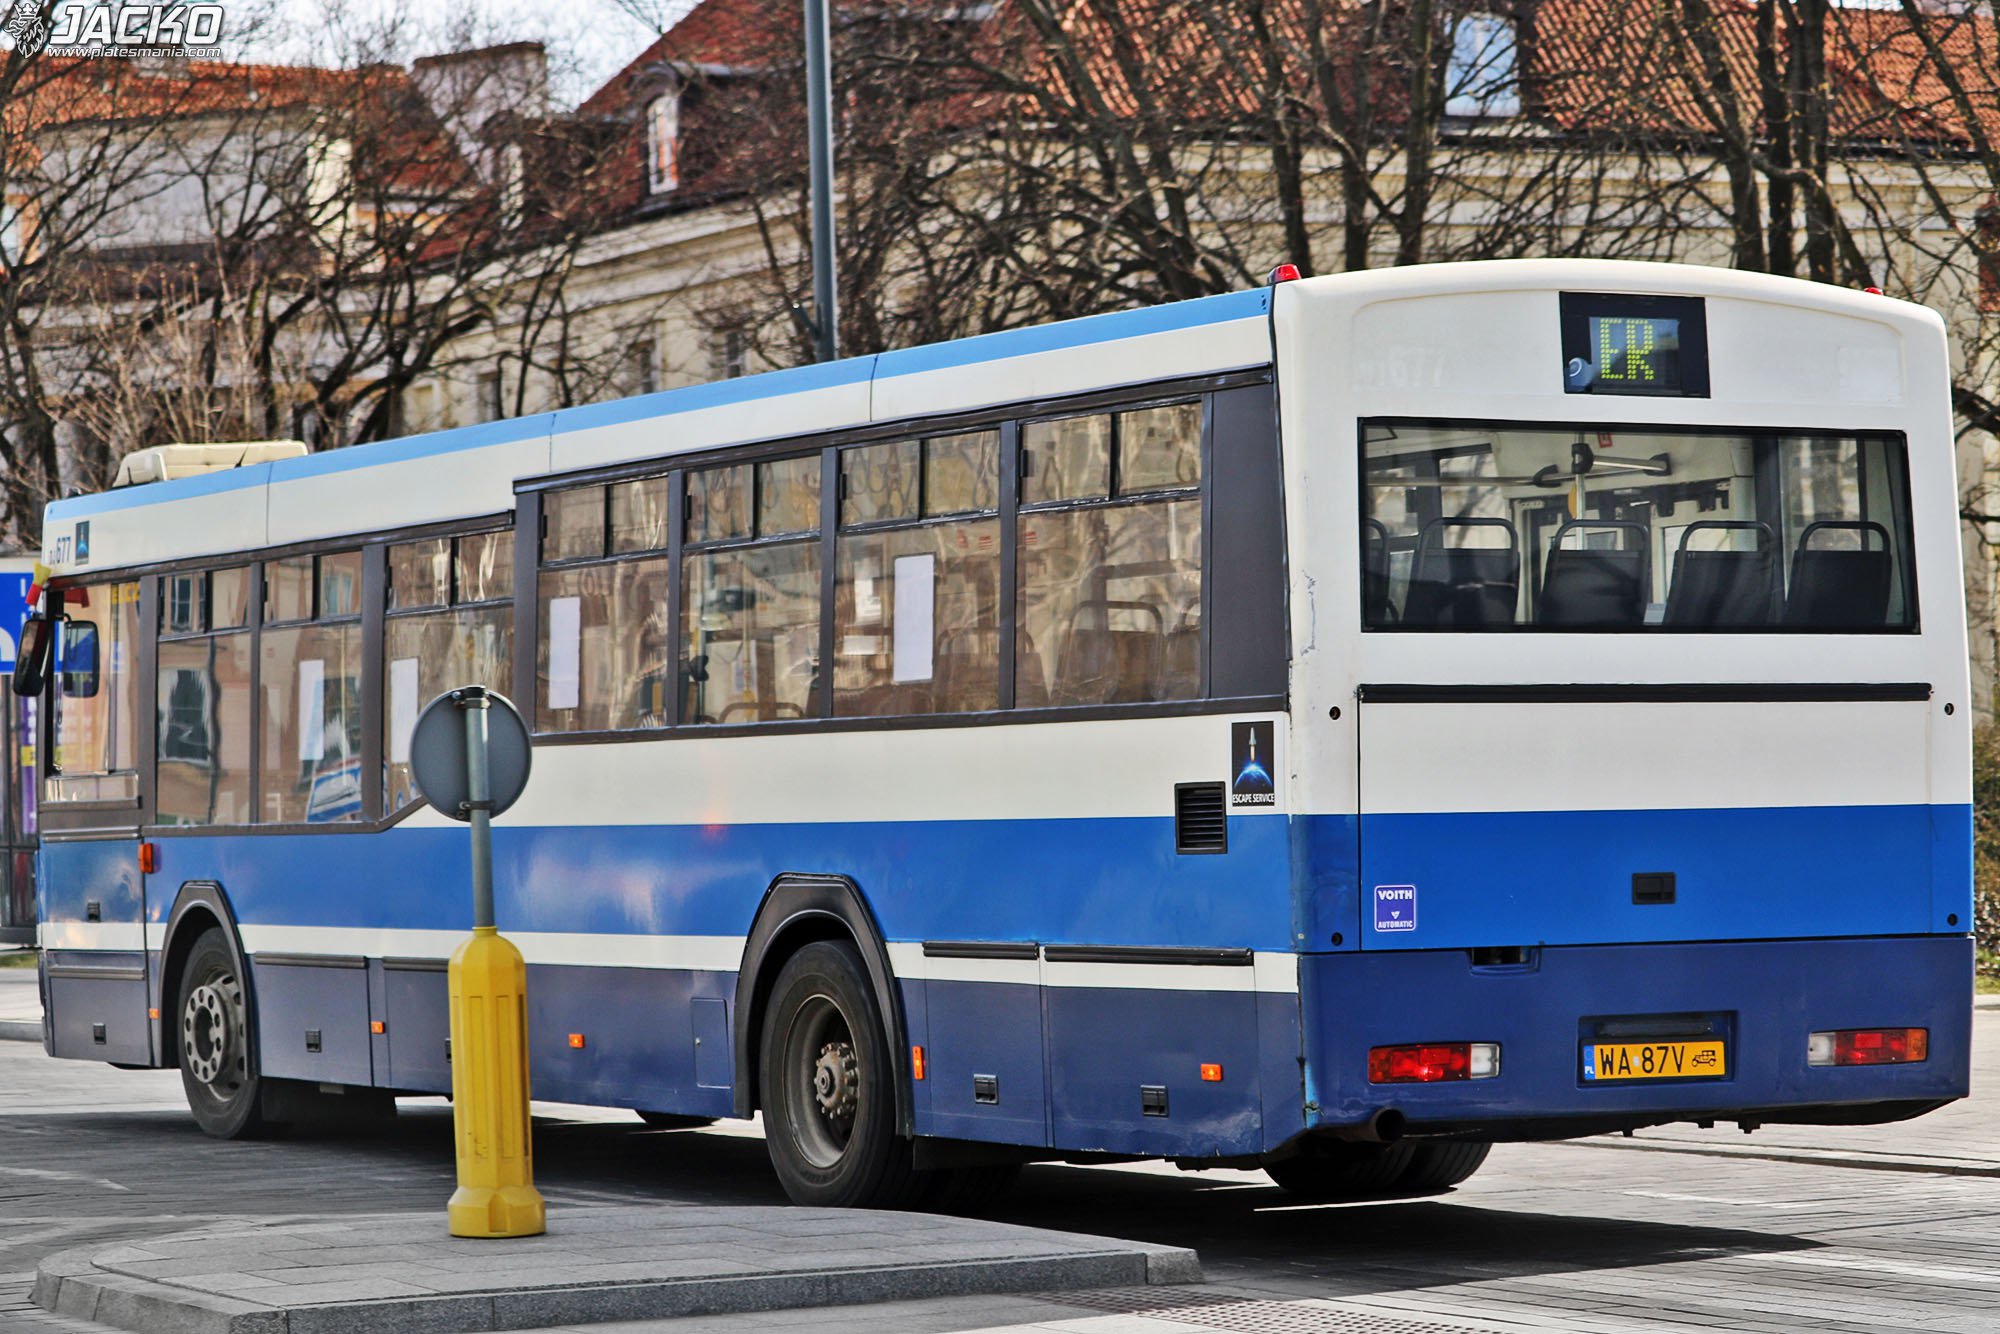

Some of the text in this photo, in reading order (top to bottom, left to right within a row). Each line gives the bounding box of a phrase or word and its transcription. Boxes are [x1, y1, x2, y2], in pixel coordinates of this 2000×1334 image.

[1600, 318, 1654, 380] ER
[1232, 793, 1275, 804] ESCAPE SERVICE
[1377, 890, 1413, 900] VOITH
[1377, 920, 1413, 929] AUTOMATIC
[1600, 1045, 1685, 1075] WA 87V
